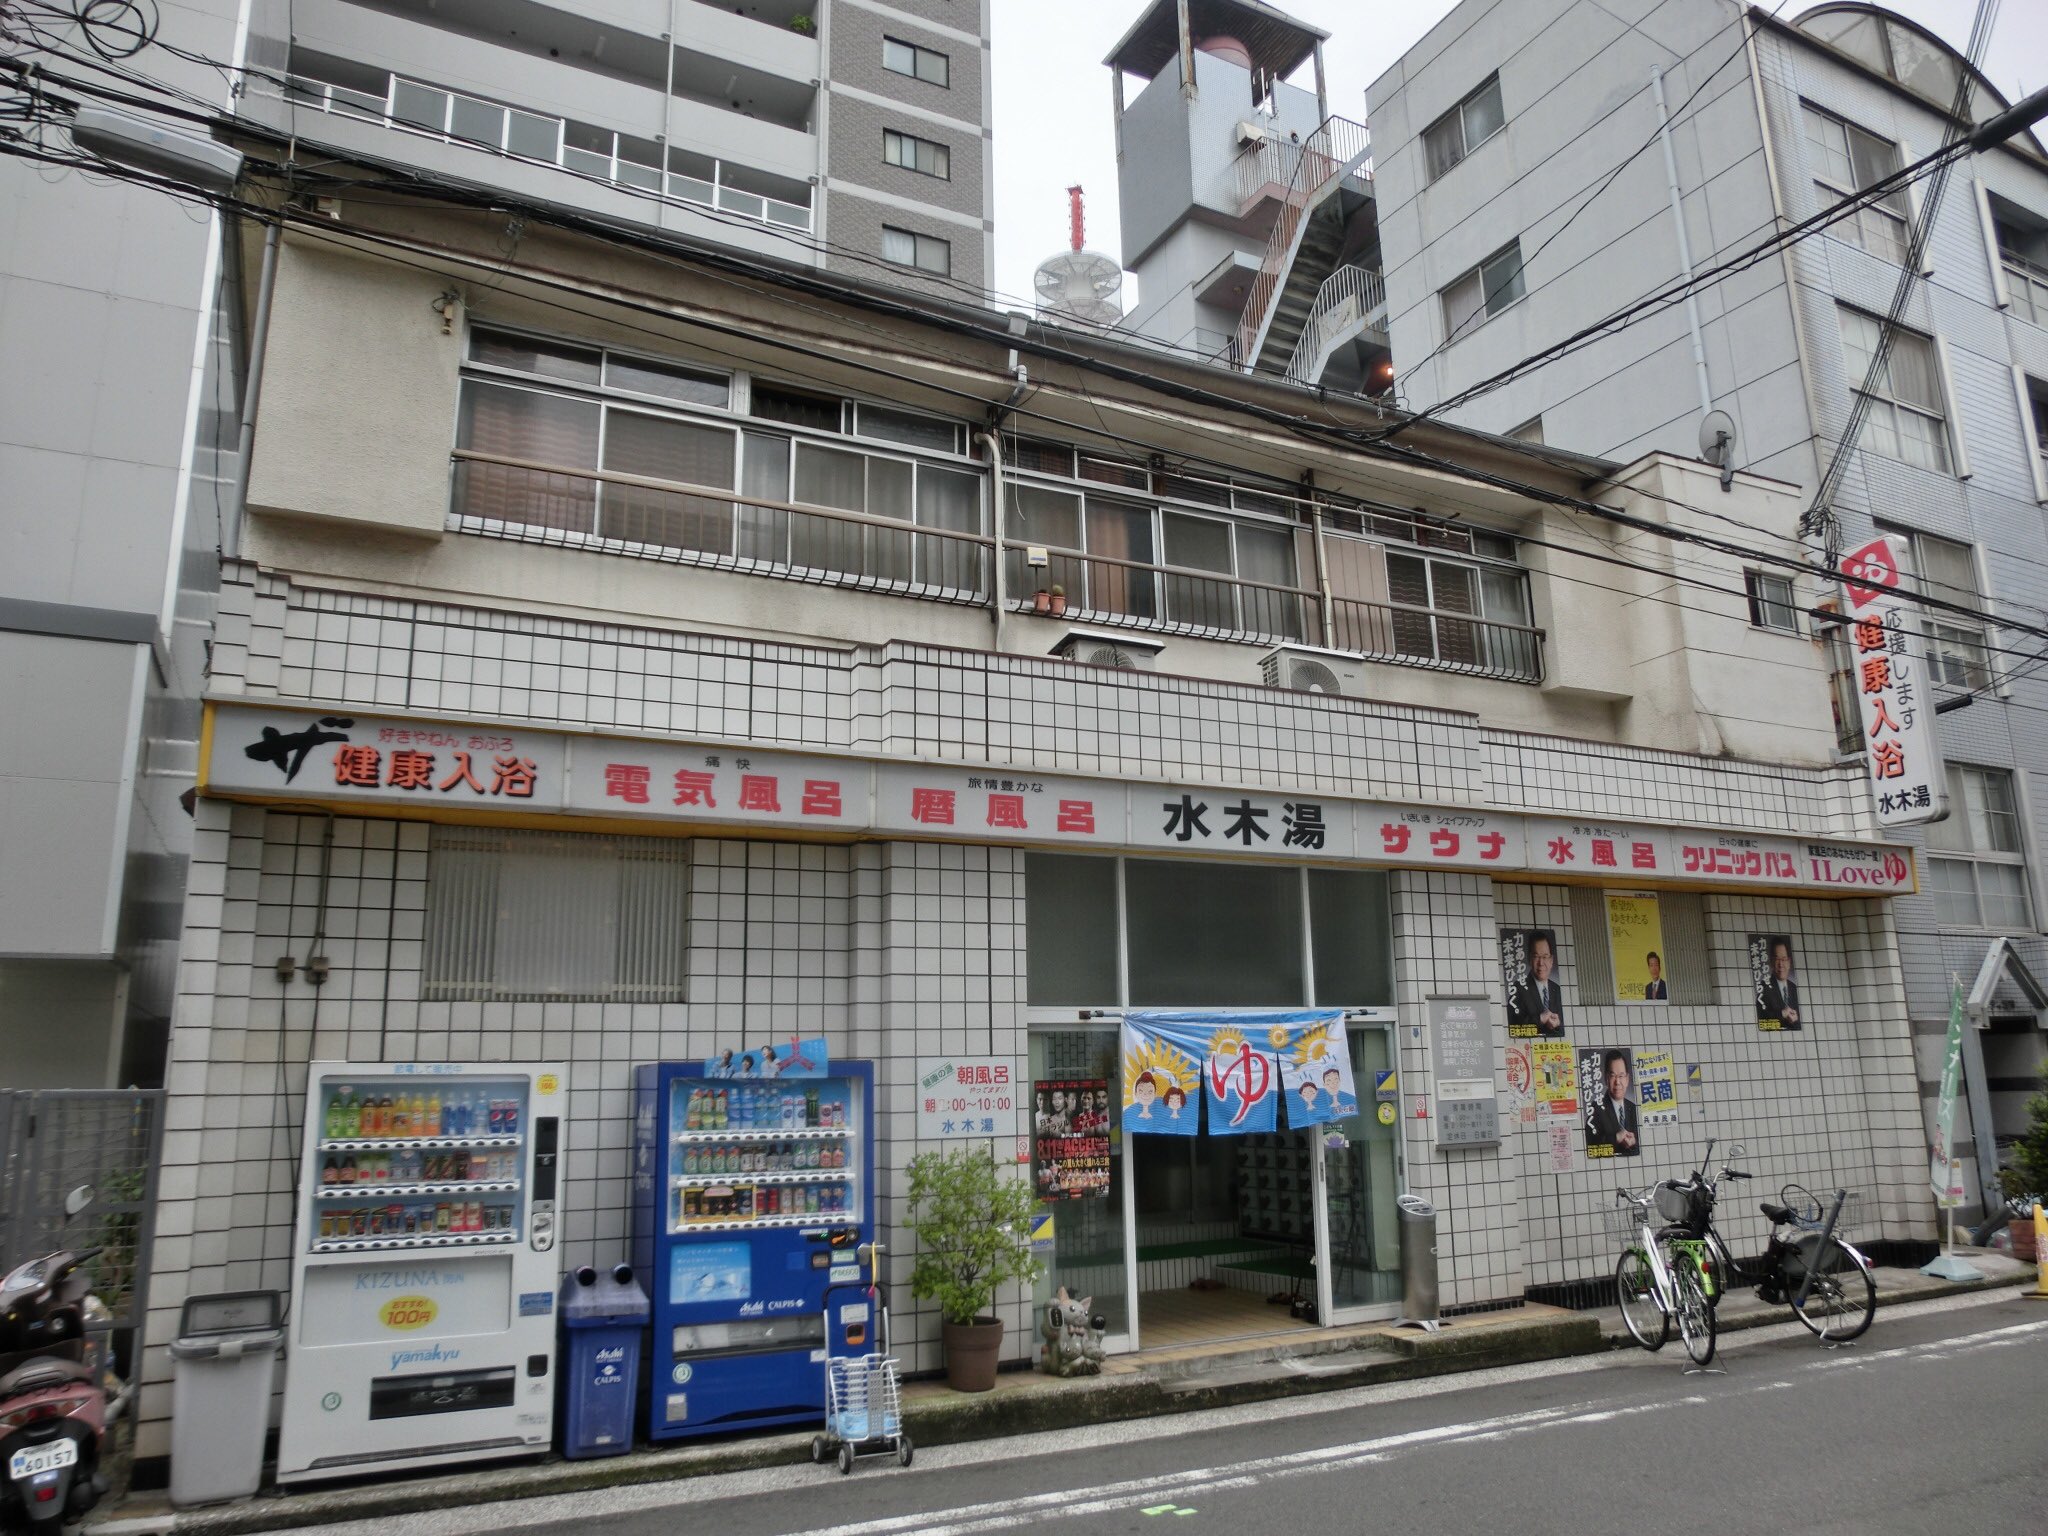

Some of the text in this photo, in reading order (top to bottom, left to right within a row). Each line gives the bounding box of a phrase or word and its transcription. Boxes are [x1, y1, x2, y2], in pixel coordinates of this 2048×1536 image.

[1854, 614, 1906, 781] 健康入浴
[378, 727, 515, 752] 好きやねん おふろ
[333, 743, 537, 798] 健康入浴
[704, 755, 751, 771] 痛快
[604, 763, 842, 817] 電気風呂
[967, 776, 1044, 794] 旅情豊かな
[1879, 784, 1931, 815] 水木湯
[910, 787, 1096, 835] 暦風呂
[1162, 794, 1326, 850] 水木湯
[1436, 815, 1485, 829] シェイプアップ
[1380, 823, 1506, 860] サウナ
[1547, 836, 1657, 869] 水風呂
[1683, 845, 1797, 878] クリニックバス
[1882, 852, 1907, 887] ゆ
[956, 1065, 1009, 1085] 朝風呂
[1210, 1040, 1271, 1127] ゆ
[1591, 1051, 1606, 1110] 力あわせ、
[1581, 1058, 1599, 1135] 未来ひらく。
[1640, 1078, 1673, 1105] 民商
[941, 1117, 994, 1134] 水木湯
[355, 1271, 439, 1290] KIZUNA
[386, 1309, 431, 1325] 100円
[391, 1343, 460, 1370] yamakyu
[25, 1449, 73, 1473] 60157
